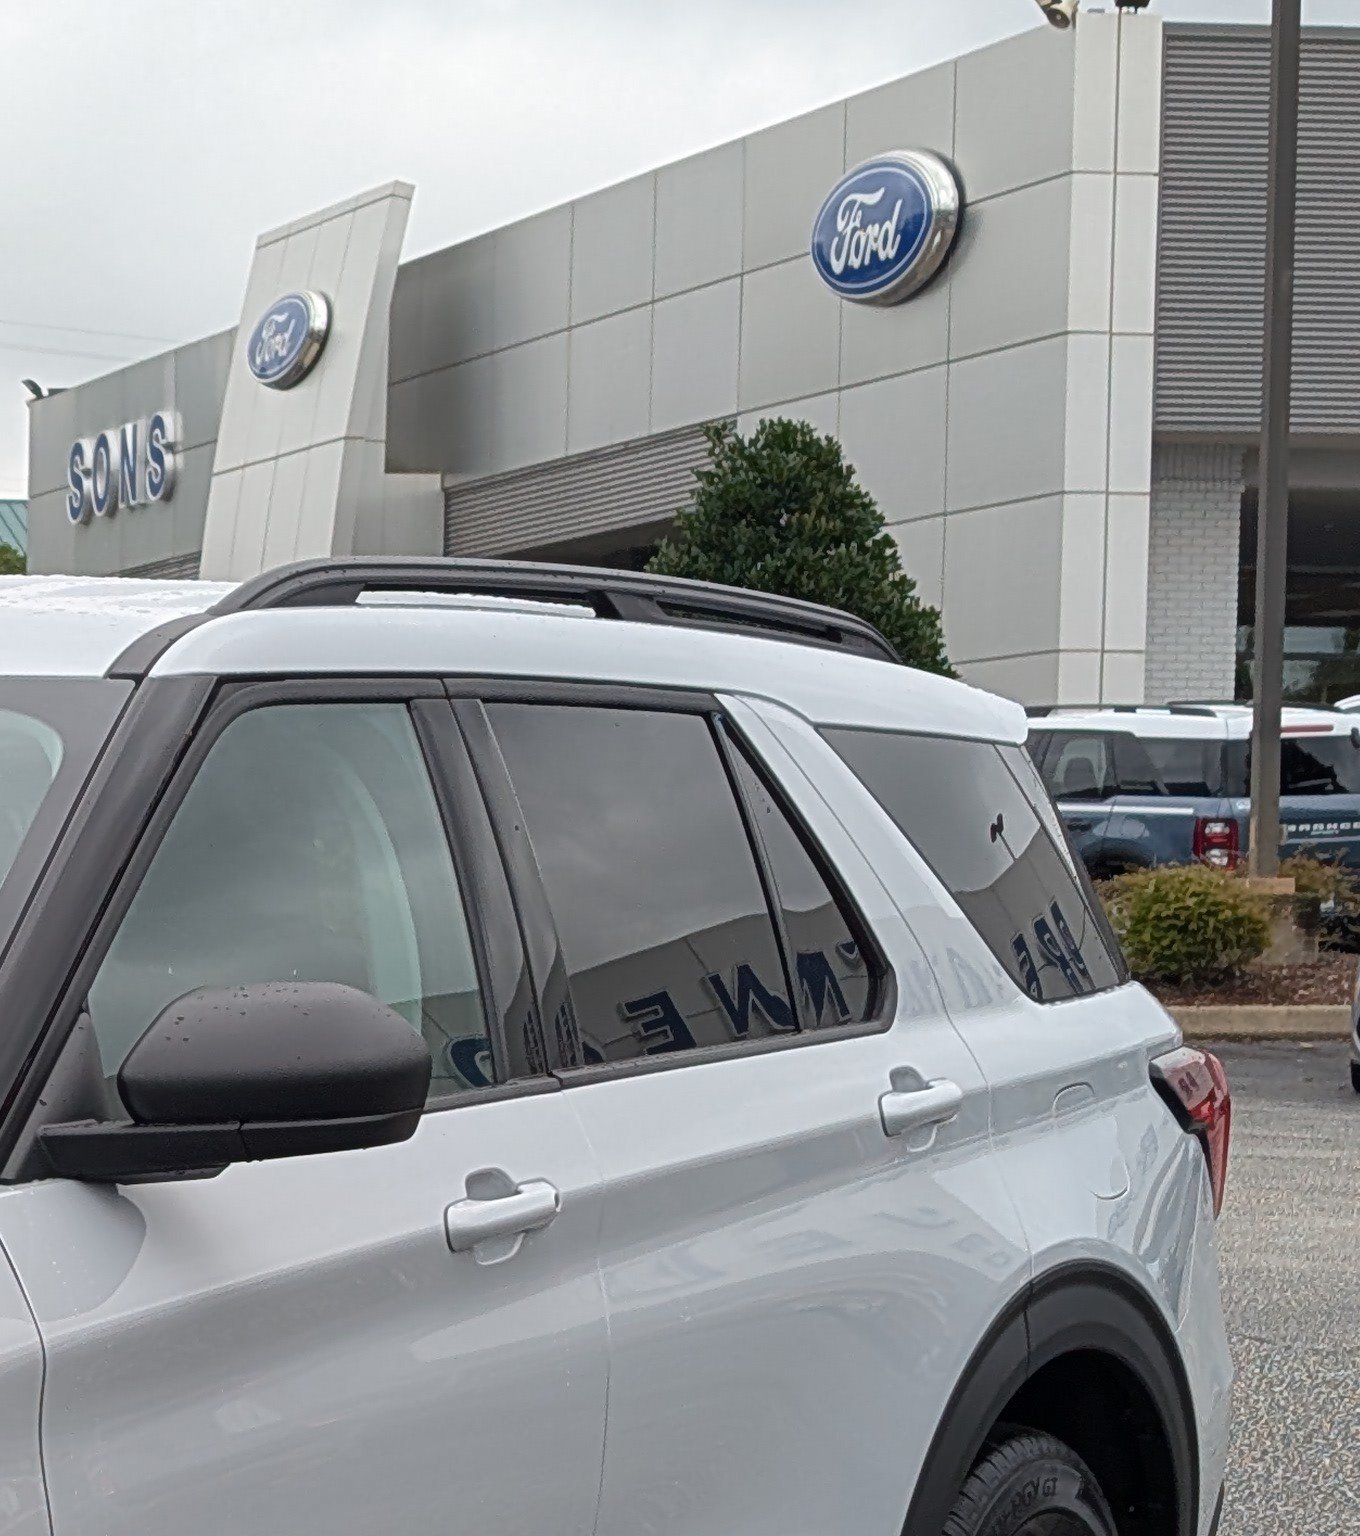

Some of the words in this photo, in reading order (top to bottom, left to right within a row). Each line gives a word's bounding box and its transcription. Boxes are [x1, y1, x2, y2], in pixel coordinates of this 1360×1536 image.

[830, 186, 903, 275] Ford
[255, 311, 296, 366] Ford
[65, 412, 168, 525] SONS
